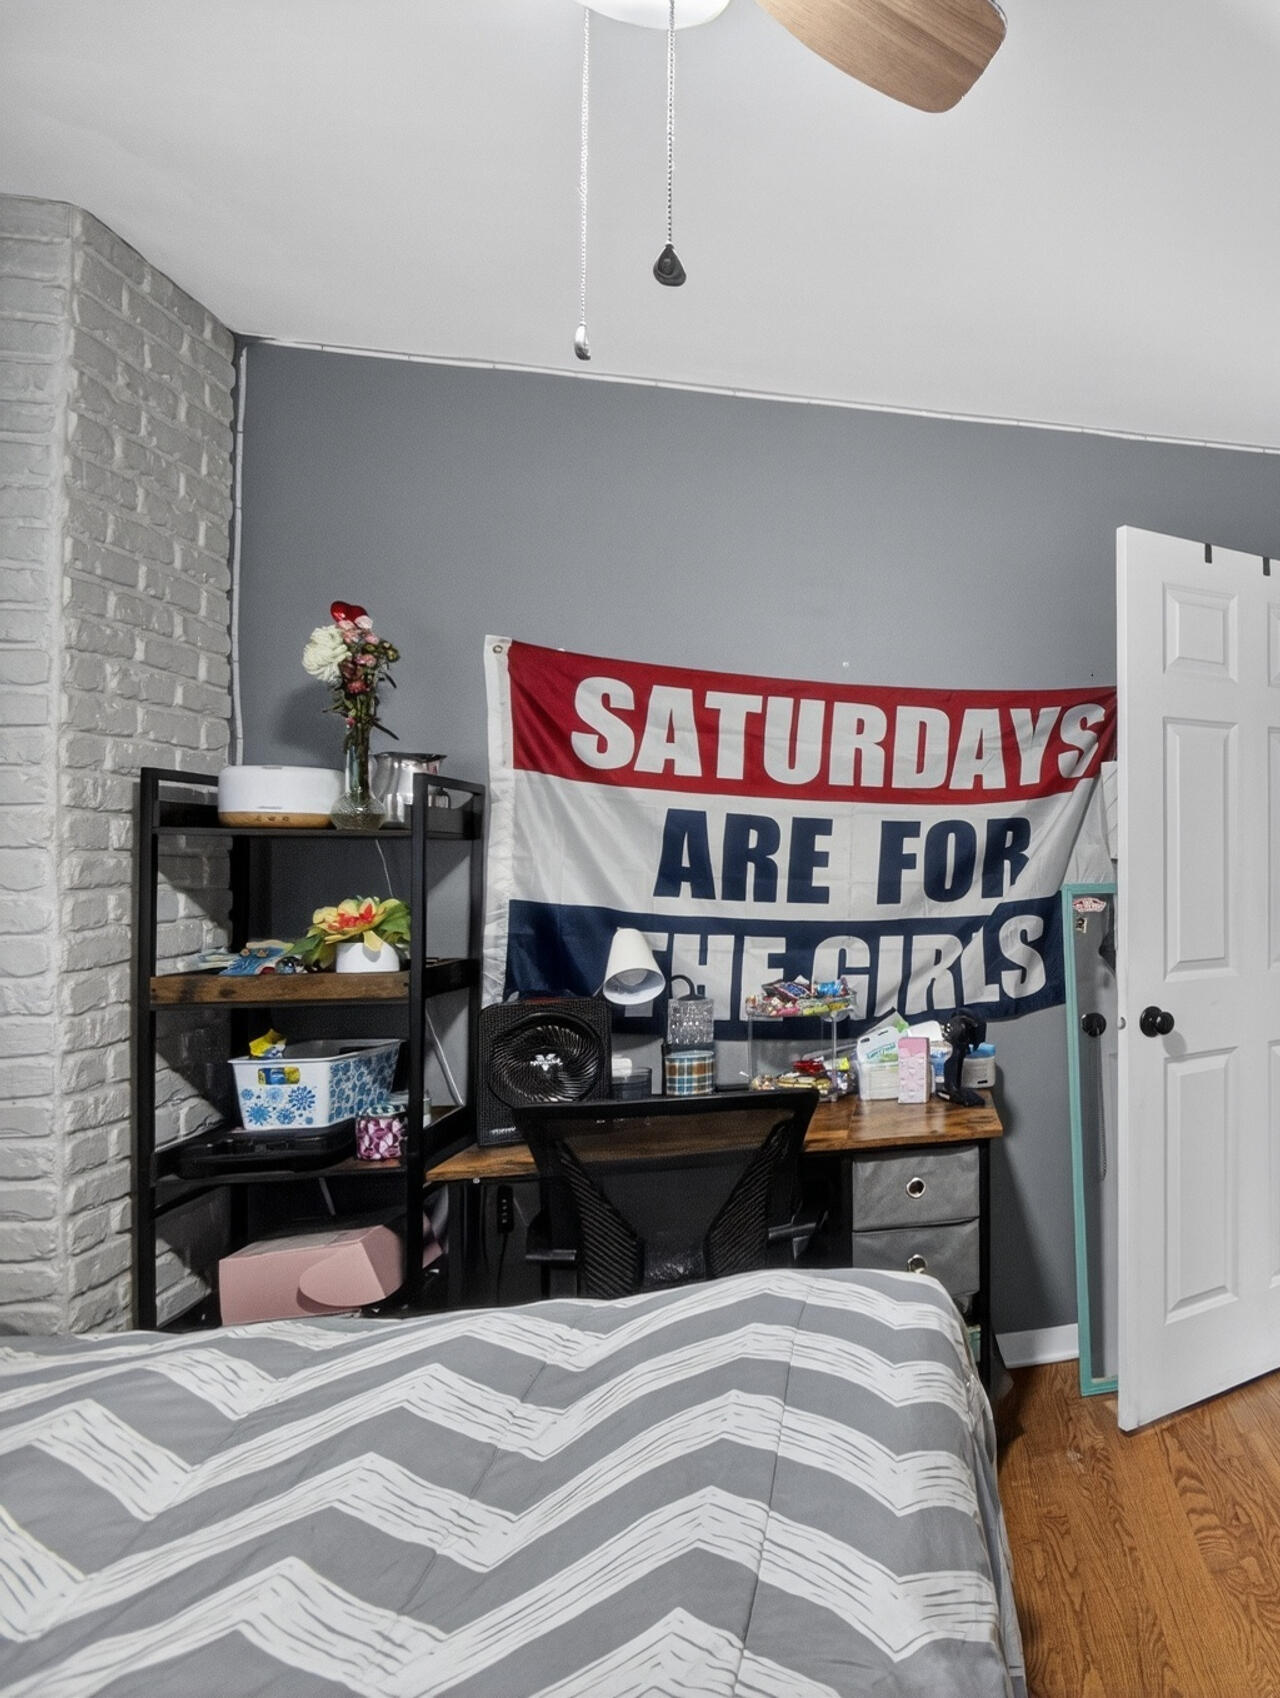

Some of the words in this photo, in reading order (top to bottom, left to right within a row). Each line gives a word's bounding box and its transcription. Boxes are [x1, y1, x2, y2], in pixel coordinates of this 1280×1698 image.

[570, 675, 1106, 790] SATURDAYS
[652, 807, 834, 904] ARE
[876, 816, 1032, 905] FOR
[622, 930, 788, 1022] HE
[811, 914, 1047, 1023] GIRLS
